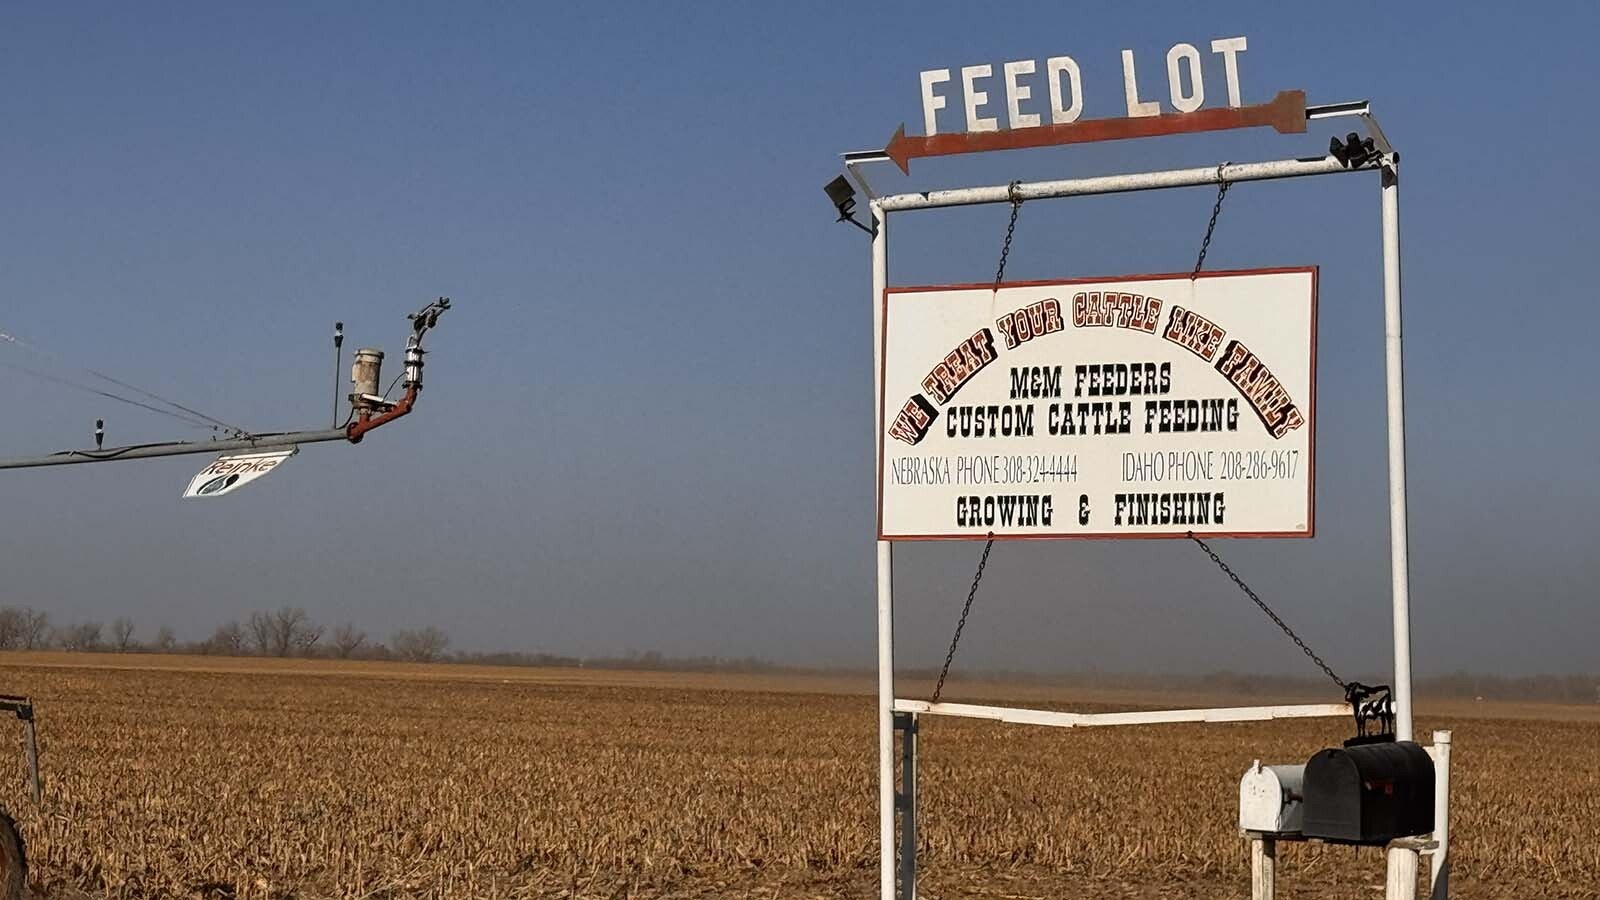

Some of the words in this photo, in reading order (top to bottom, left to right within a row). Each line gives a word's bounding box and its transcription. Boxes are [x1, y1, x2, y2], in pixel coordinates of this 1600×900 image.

[920, 56, 1084, 136] FEED
[1121, 36, 1248, 118] LOT
[888, 394, 939, 446] WE
[921, 328, 998, 406] TREAT
[996, 298, 1064, 350] YOUR
[1072, 291, 1163, 334] CATTLE
[1162, 305, 1226, 362] LIKE
[1214, 340, 1305, 440] FAMILY
[1010, 366, 1062, 399] M&M
[1075, 362, 1171, 397] FEEDERS
[947, 404, 1034, 438] CUSTOM
[1049, 401, 1131, 435] CATTLE
[1145, 398, 1239, 433] FEEDING
[200, 457, 277, 475] Reinke
[892, 454, 950, 485] NEBRASKA
[957, 455, 999, 484] PHONE
[1002, 454, 1078, 483] 308-324-4444
[1122, 452, 1164, 481] IDAHO
[1168, 451, 1213, 481] PHONE
[1220, 450, 1299, 480] 208-286-9617
[957, 495, 1053, 527] GROWING
[1078, 494, 1090, 526] &
[1114, 492, 1225, 526] FINISHING
